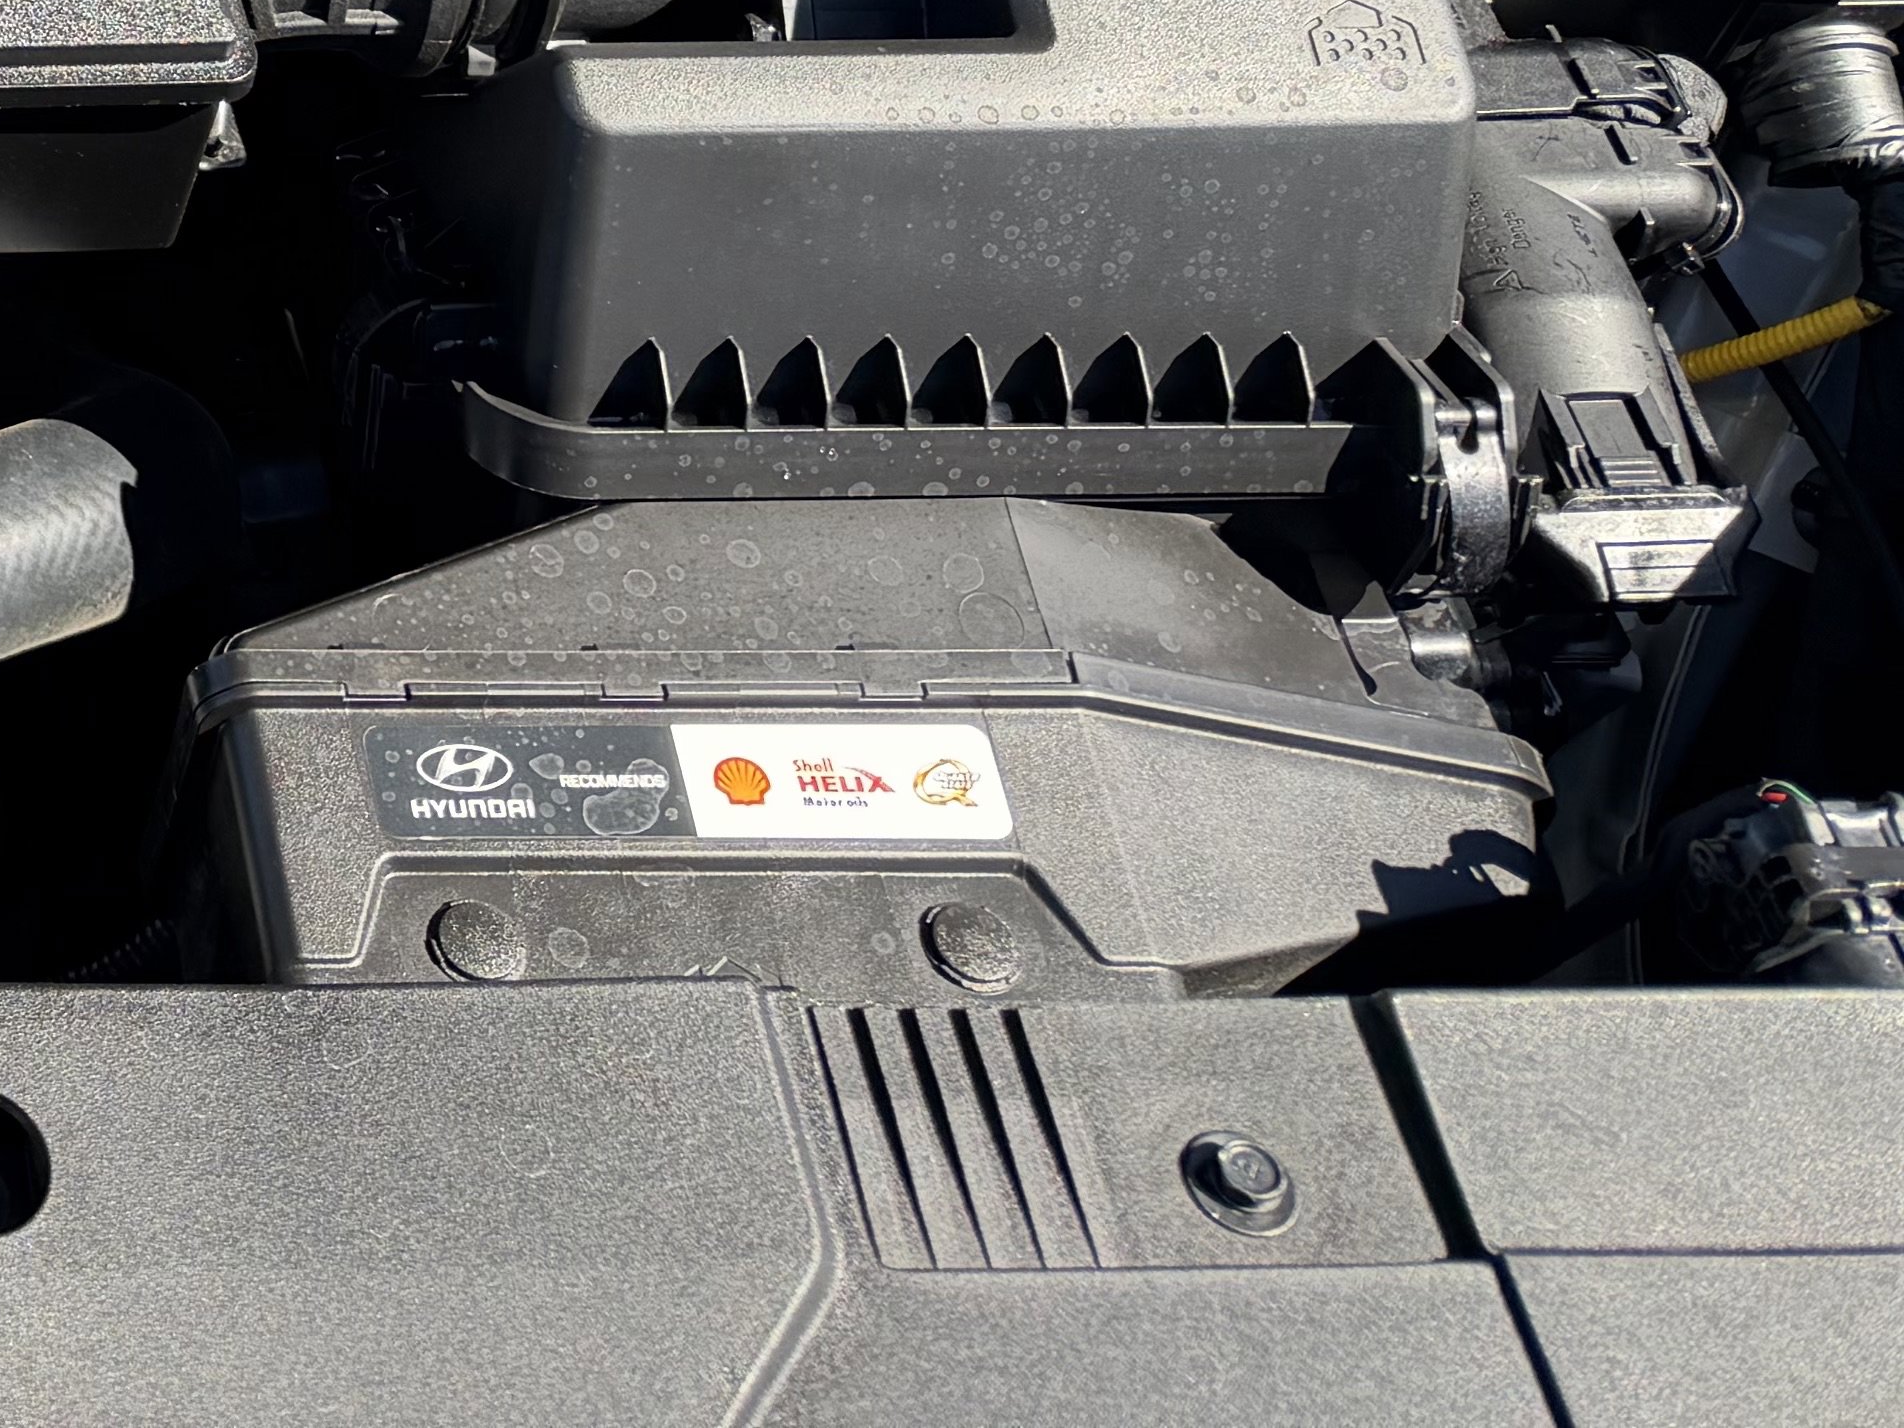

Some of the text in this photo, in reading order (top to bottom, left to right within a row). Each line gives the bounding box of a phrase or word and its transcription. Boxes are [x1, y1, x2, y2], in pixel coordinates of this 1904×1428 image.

[792, 758, 834, 772] Shell
[559, 774, 667, 789] RECOMMENDS
[797, 773, 894, 793] HELIX
[409, 799, 536, 819] HYUNDAI
[803, 796, 844, 807] Motor
